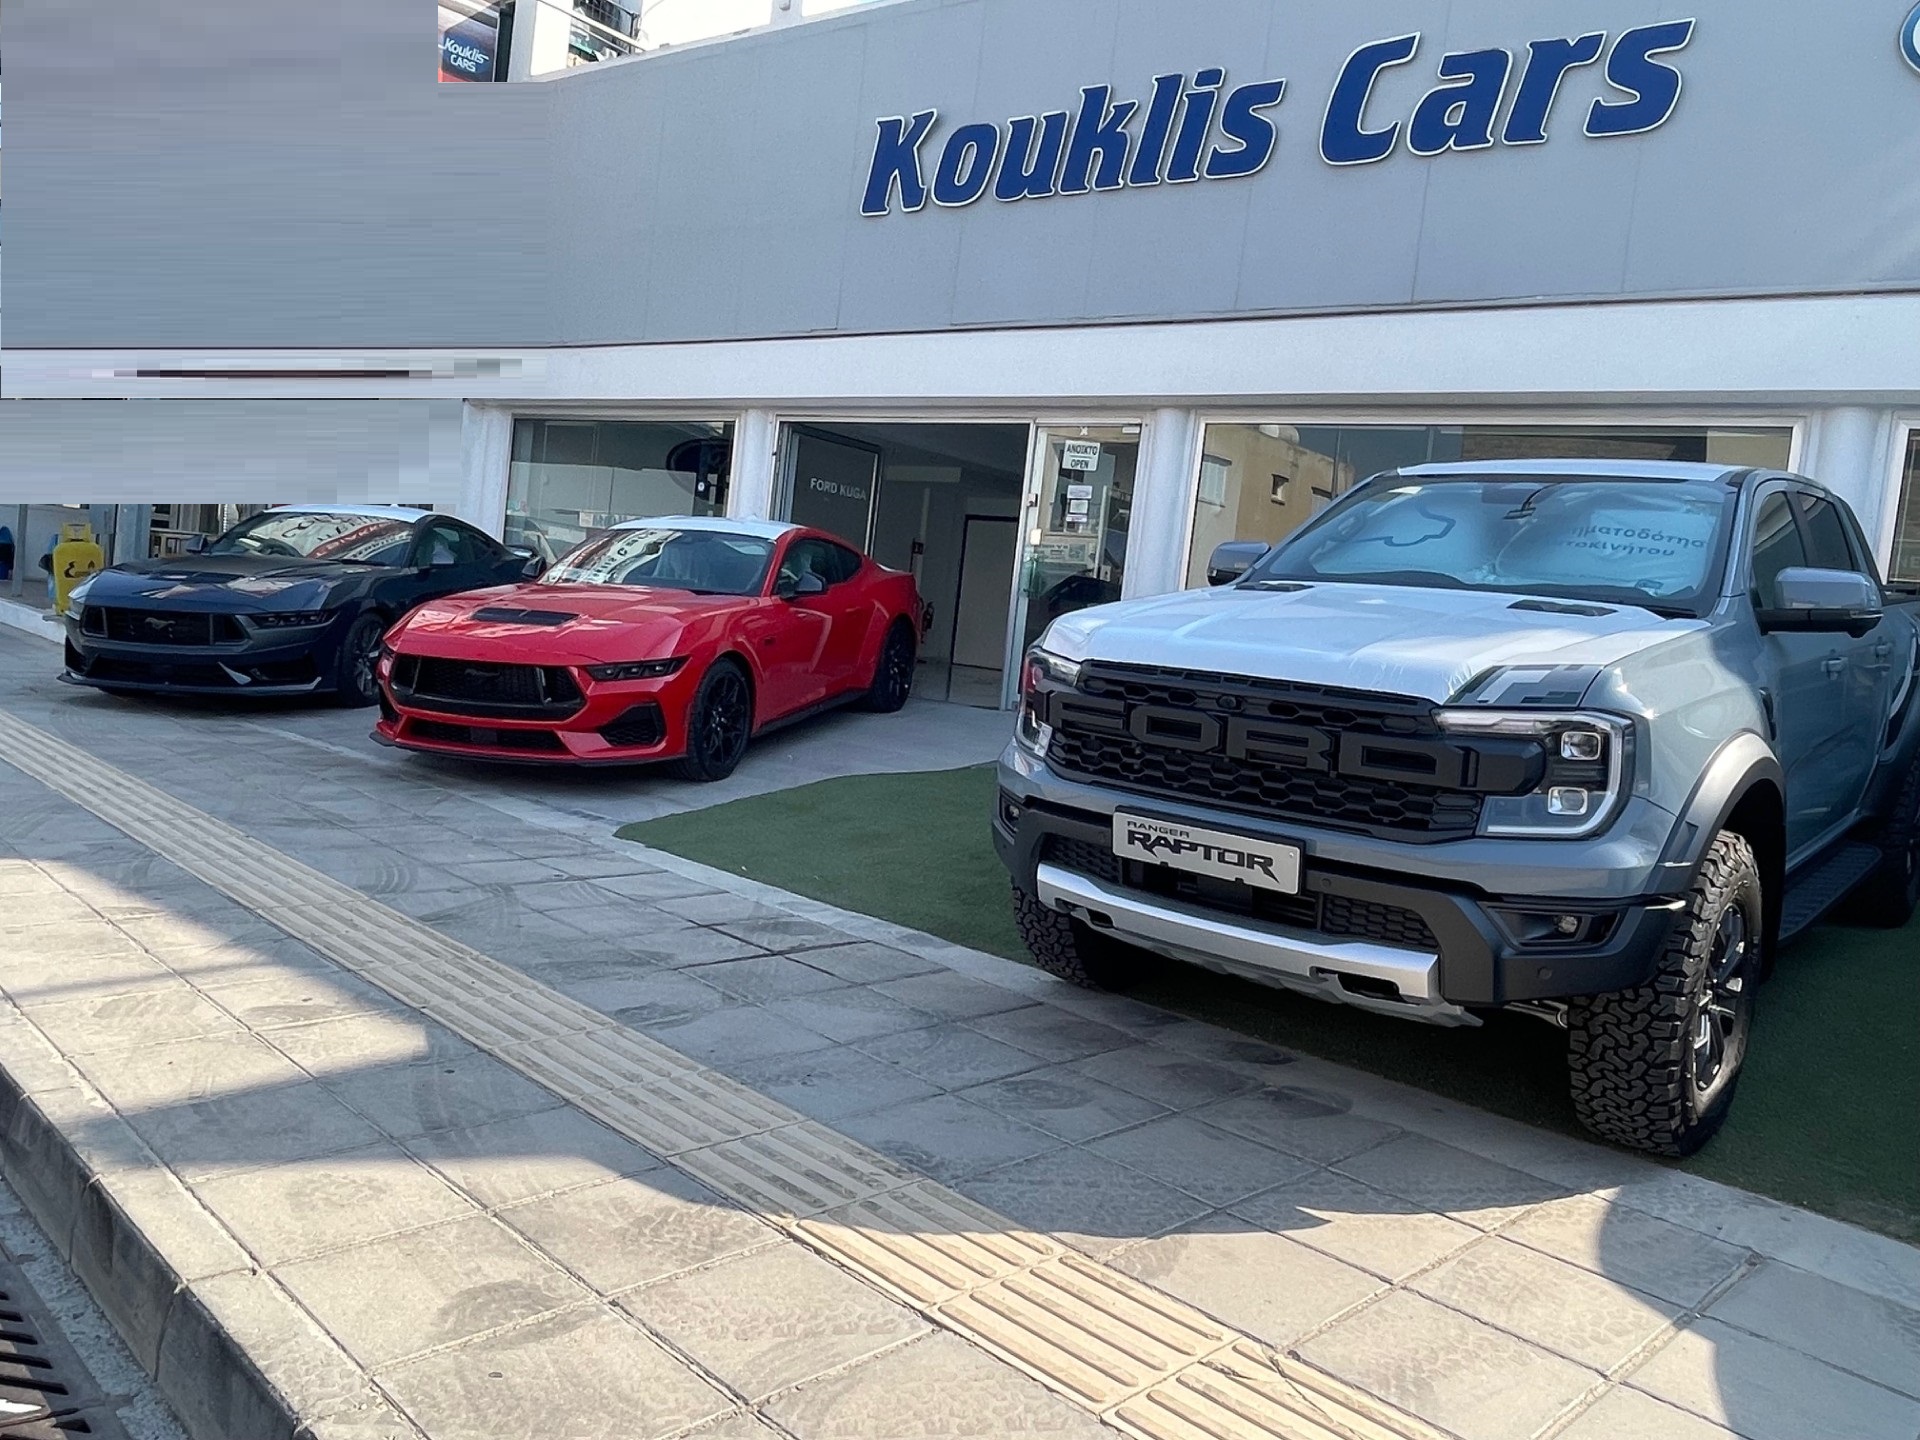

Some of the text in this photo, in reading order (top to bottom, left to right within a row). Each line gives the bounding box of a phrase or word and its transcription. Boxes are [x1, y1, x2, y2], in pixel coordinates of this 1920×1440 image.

[442, 37, 489, 64] Kouklis
[450, 54, 476, 72] CARS
[860, 17, 1697, 217] Kouklis Cars
[1070, 459, 1089, 469] OPEN
[810, 478, 867, 501] FORD KUGA
[1566, 540, 1675, 557] τοκινήτου
[1049, 691, 1466, 788] FORD
[1127, 820, 1190, 839] RANGER
[1127, 830, 1280, 884] RAPTOR
